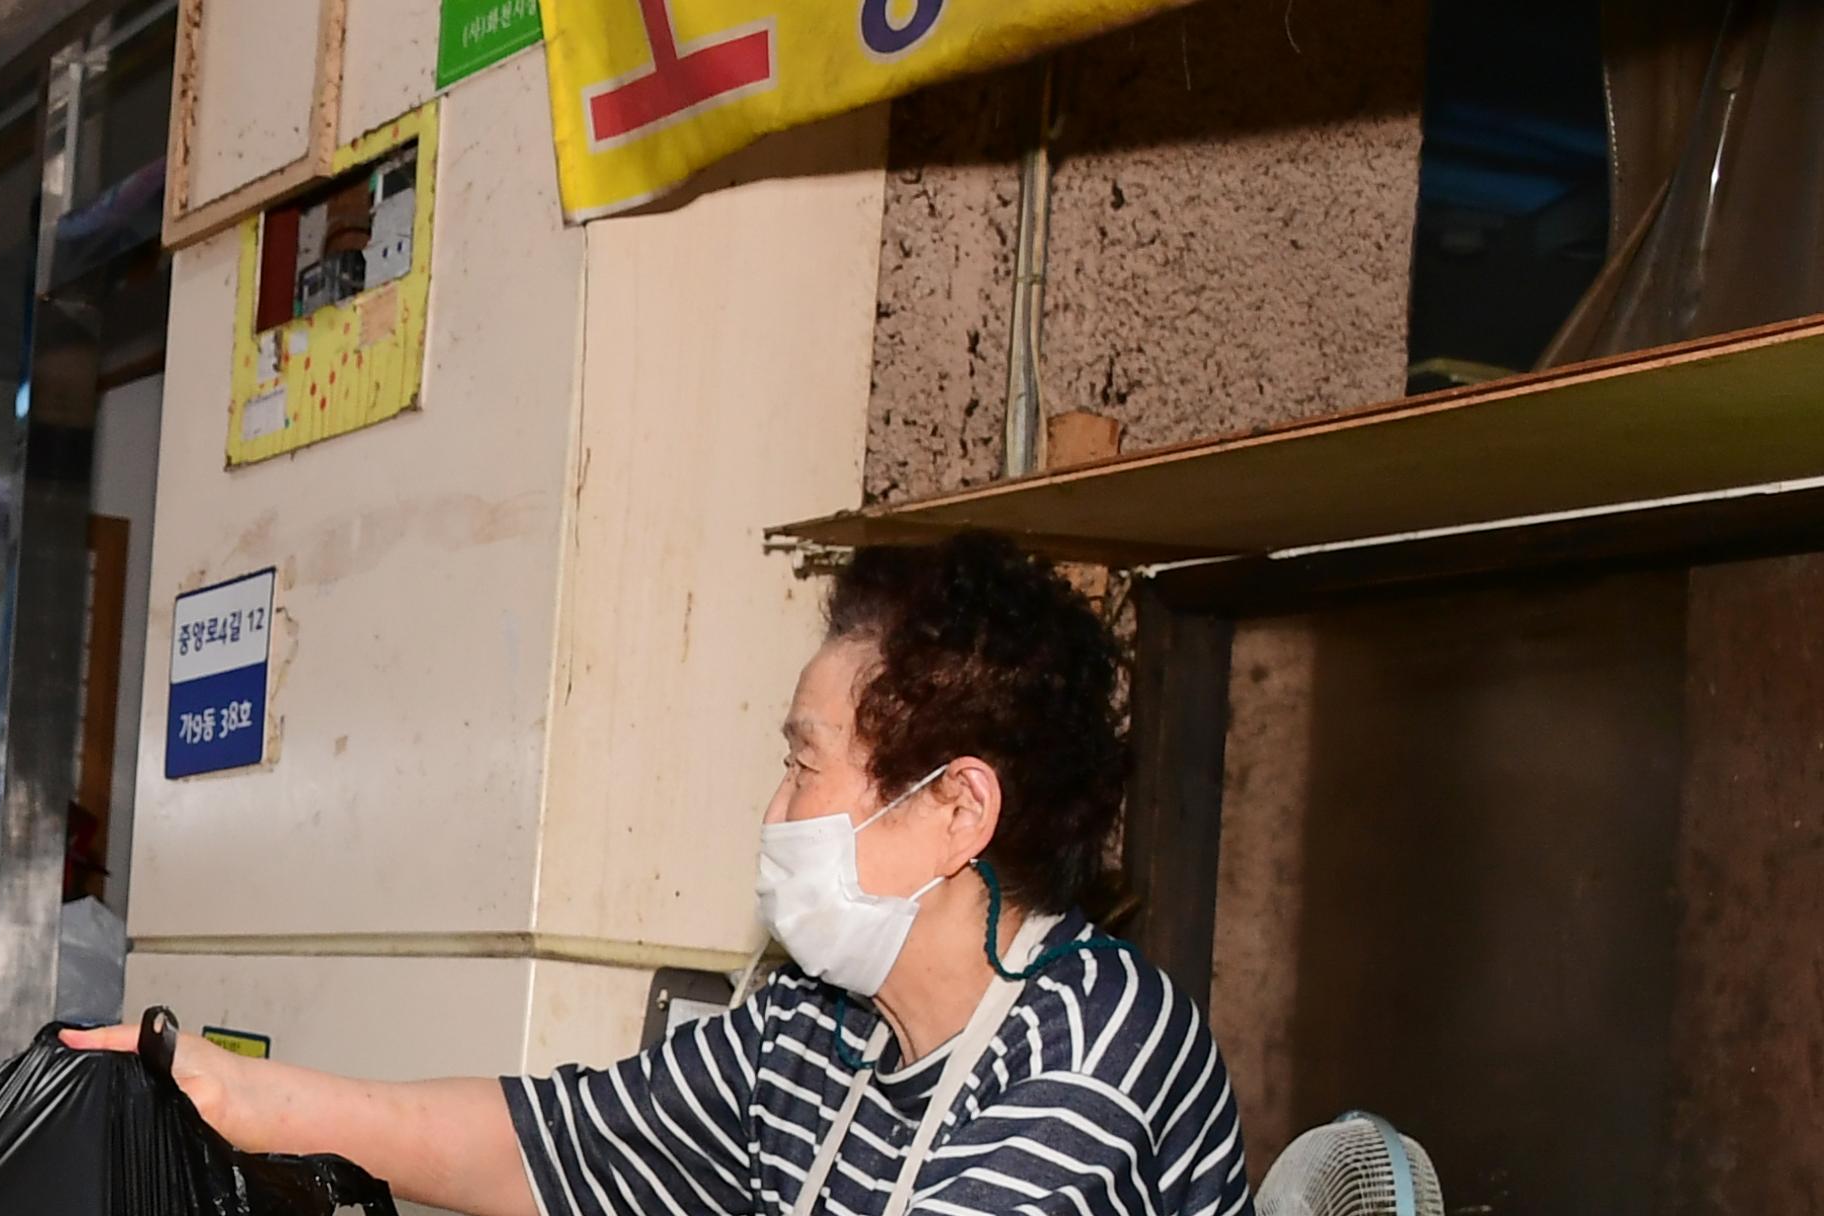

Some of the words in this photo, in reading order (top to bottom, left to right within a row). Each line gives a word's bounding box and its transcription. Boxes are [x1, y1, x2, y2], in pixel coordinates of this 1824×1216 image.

[178, 611, 243, 657] 중앙로4길
[247, 606, 266, 634] 12
[179, 708, 216, 745] 가9동
[219, 700, 253, 739] 38호
